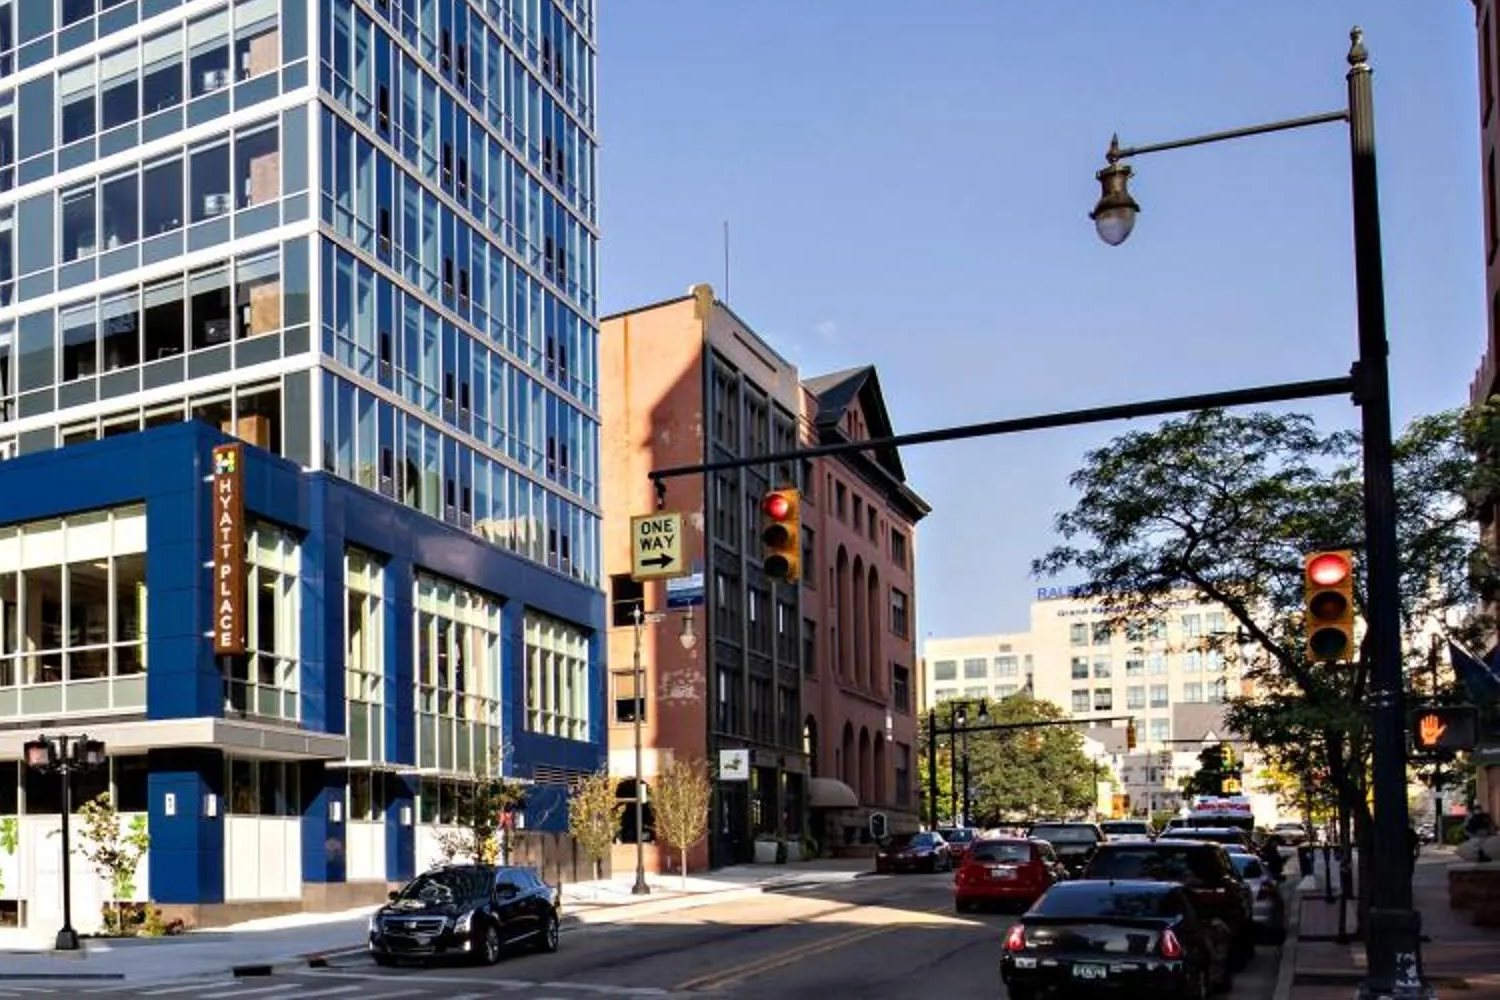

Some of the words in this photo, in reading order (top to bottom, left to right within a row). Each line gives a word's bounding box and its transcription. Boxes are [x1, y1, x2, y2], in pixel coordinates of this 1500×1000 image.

[219, 479, 232, 558] HYATT
[639, 534, 675, 551] WAY
[641, 518, 673, 534] ONE
[219, 565, 232, 647] PLACE
